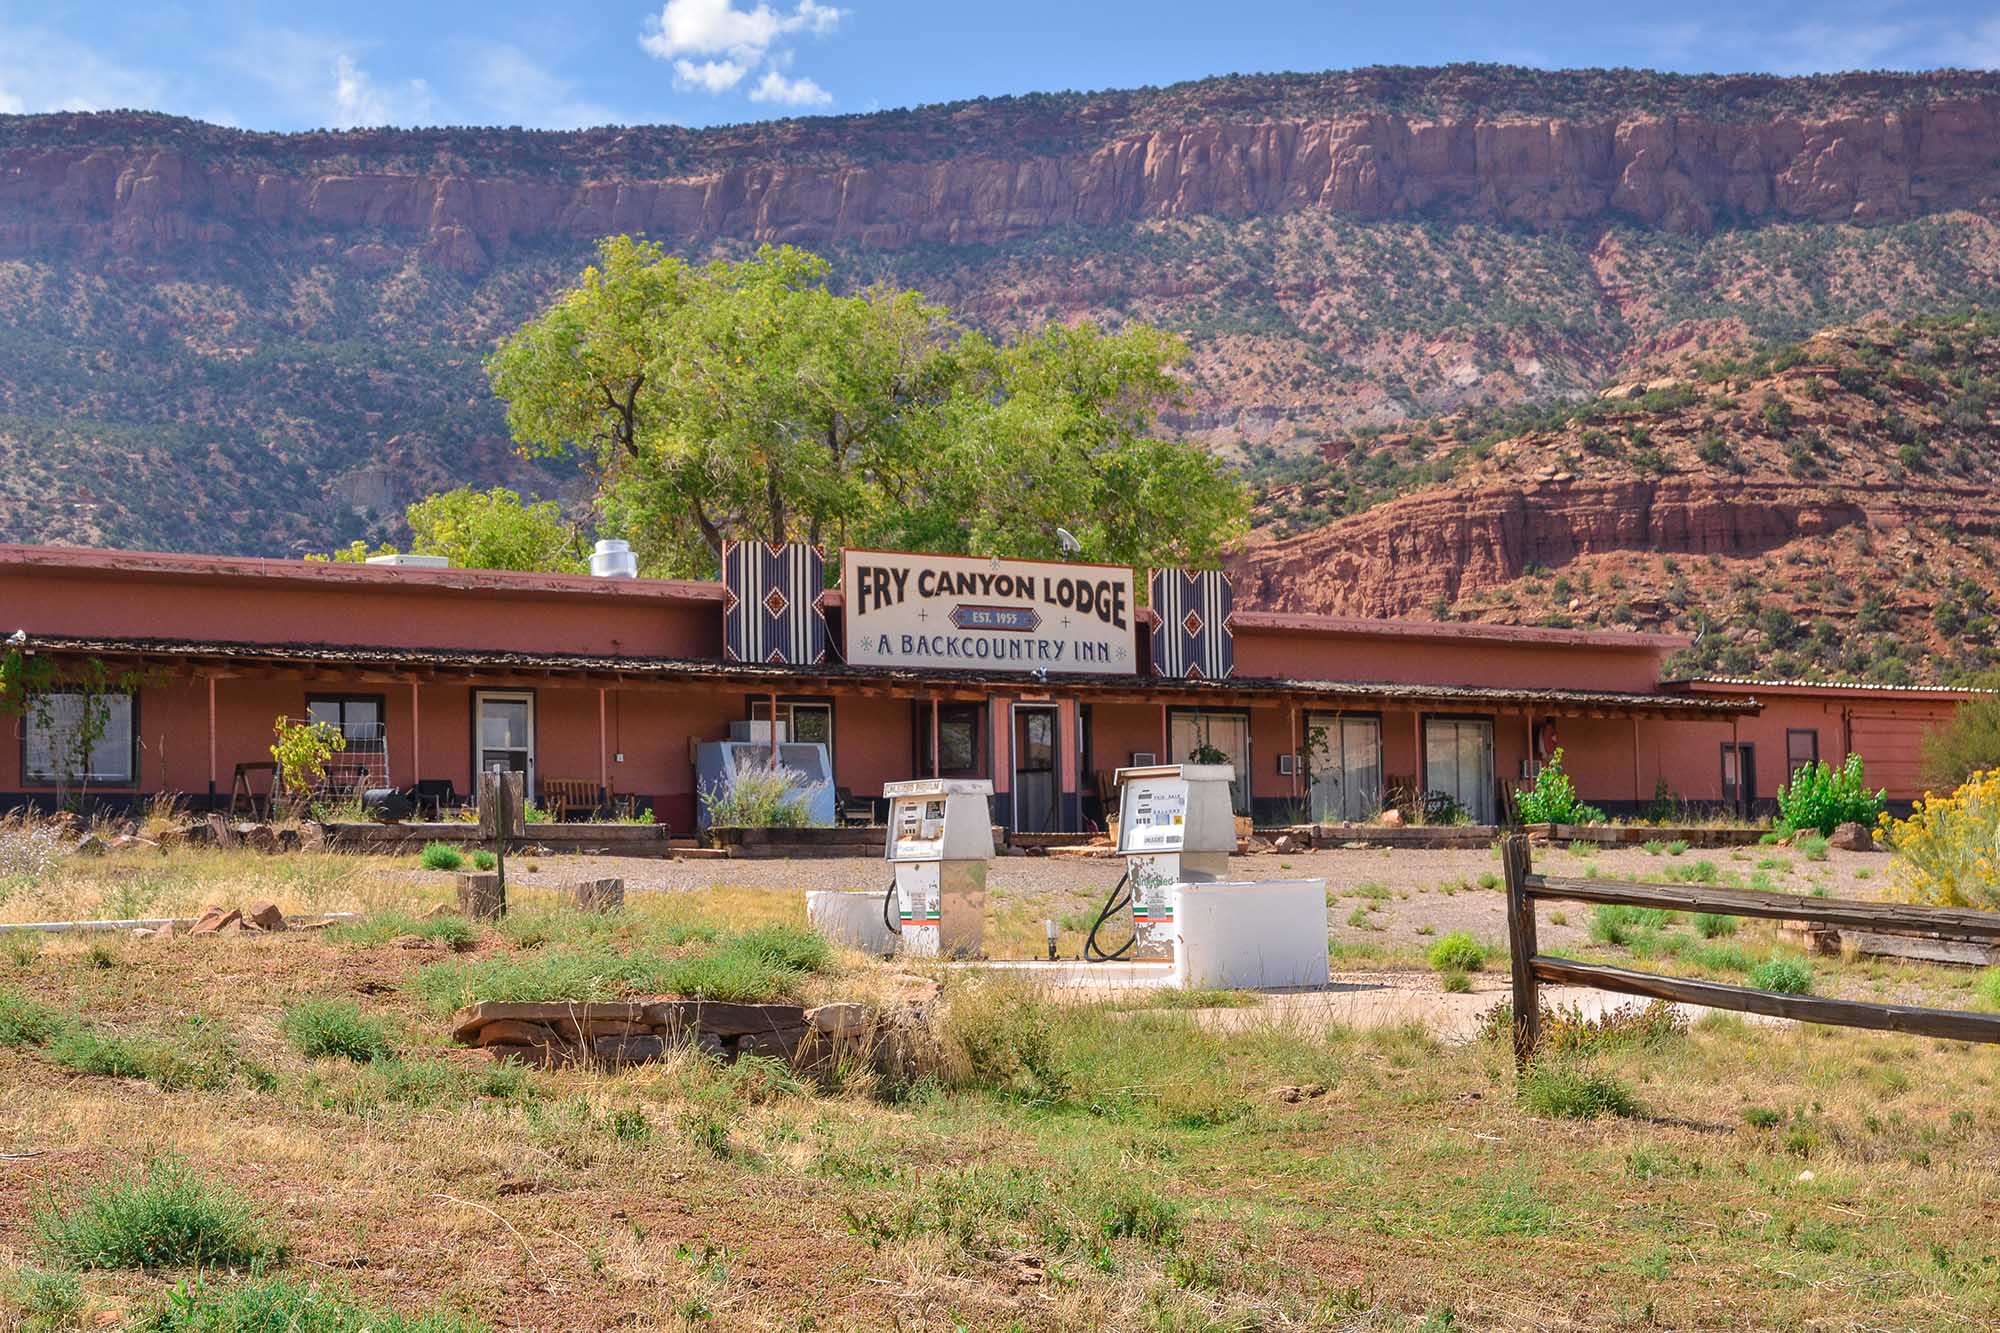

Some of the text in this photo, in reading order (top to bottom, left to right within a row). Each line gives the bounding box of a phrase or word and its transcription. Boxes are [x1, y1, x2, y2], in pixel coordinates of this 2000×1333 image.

[857, 566, 1127, 631] FRY CANYON LODGE
[973, 611, 1017, 625] EST. 1955
[878, 634, 1111, 662] A BACKCOUNTRY INN
